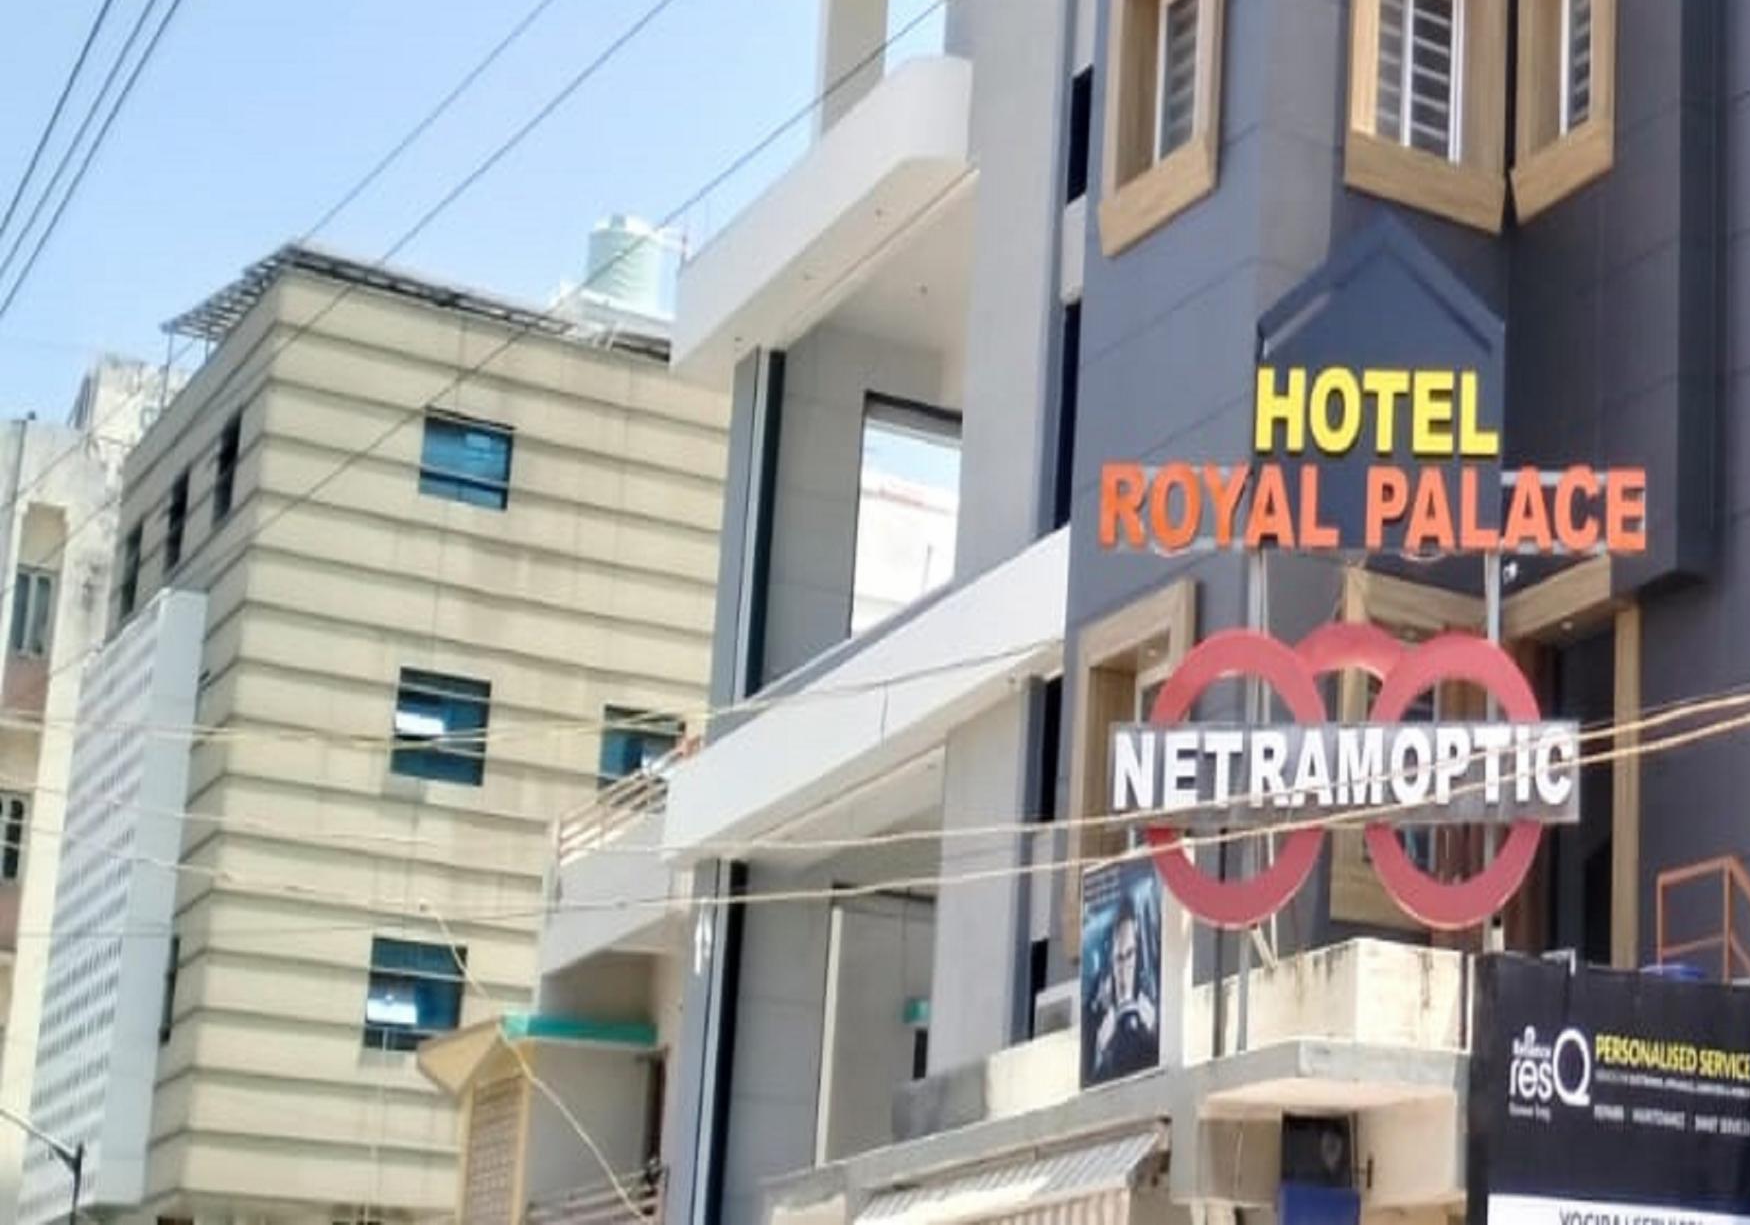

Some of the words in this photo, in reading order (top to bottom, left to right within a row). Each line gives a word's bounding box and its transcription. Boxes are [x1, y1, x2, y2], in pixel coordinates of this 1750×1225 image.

[1254, 367, 1500, 456] HOTEL
[1100, 461, 1340, 550] ROYAL
[1366, 465, 1647, 551] PALACE
[1112, 727, 1575, 810] NETRAMOPTIC
[1595, 1034, 1698, 1073] PERSONALISED
